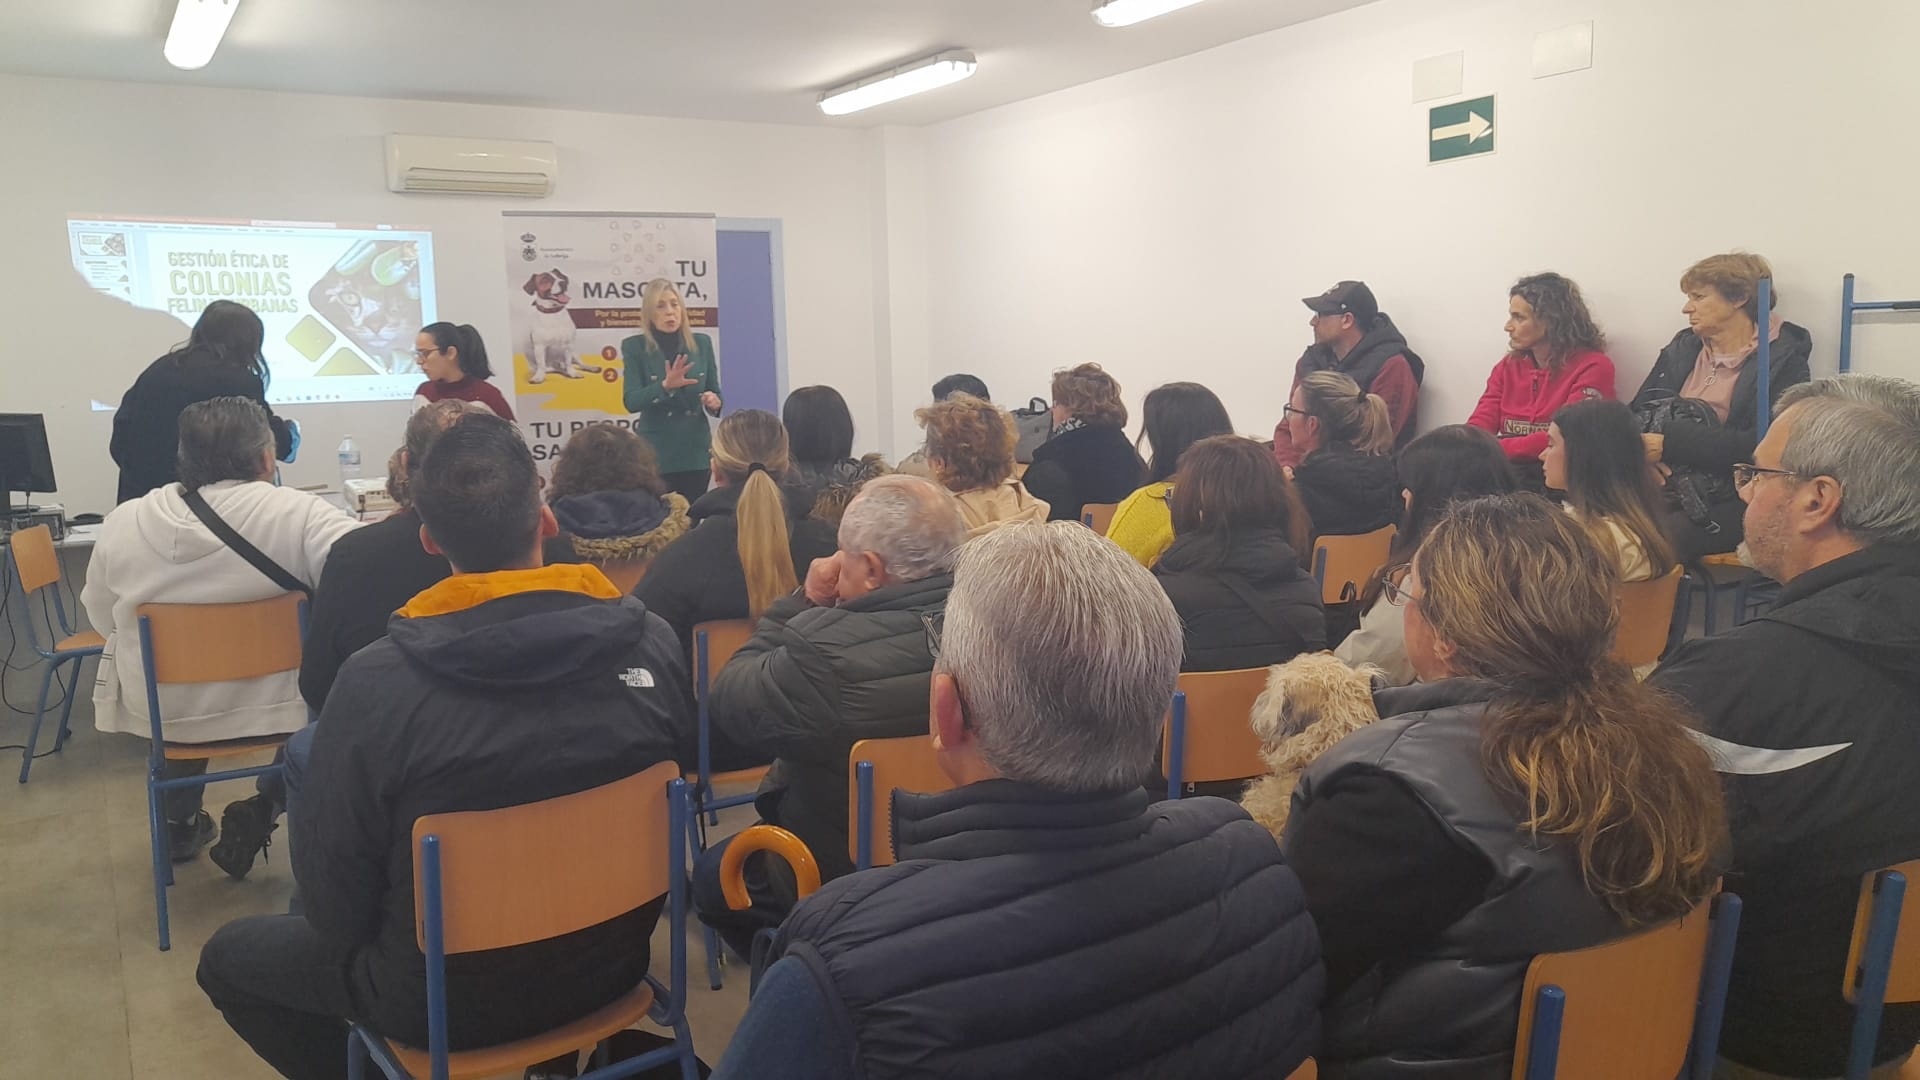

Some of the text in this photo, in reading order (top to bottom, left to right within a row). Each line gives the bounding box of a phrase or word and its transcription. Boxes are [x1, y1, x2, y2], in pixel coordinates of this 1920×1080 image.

[168, 249, 289, 268] GESTIÓN ÉTICA DE
[675, 260, 706, 277] TU
[169, 270, 292, 296] COLONIAS
[530, 422, 562, 438] TU
